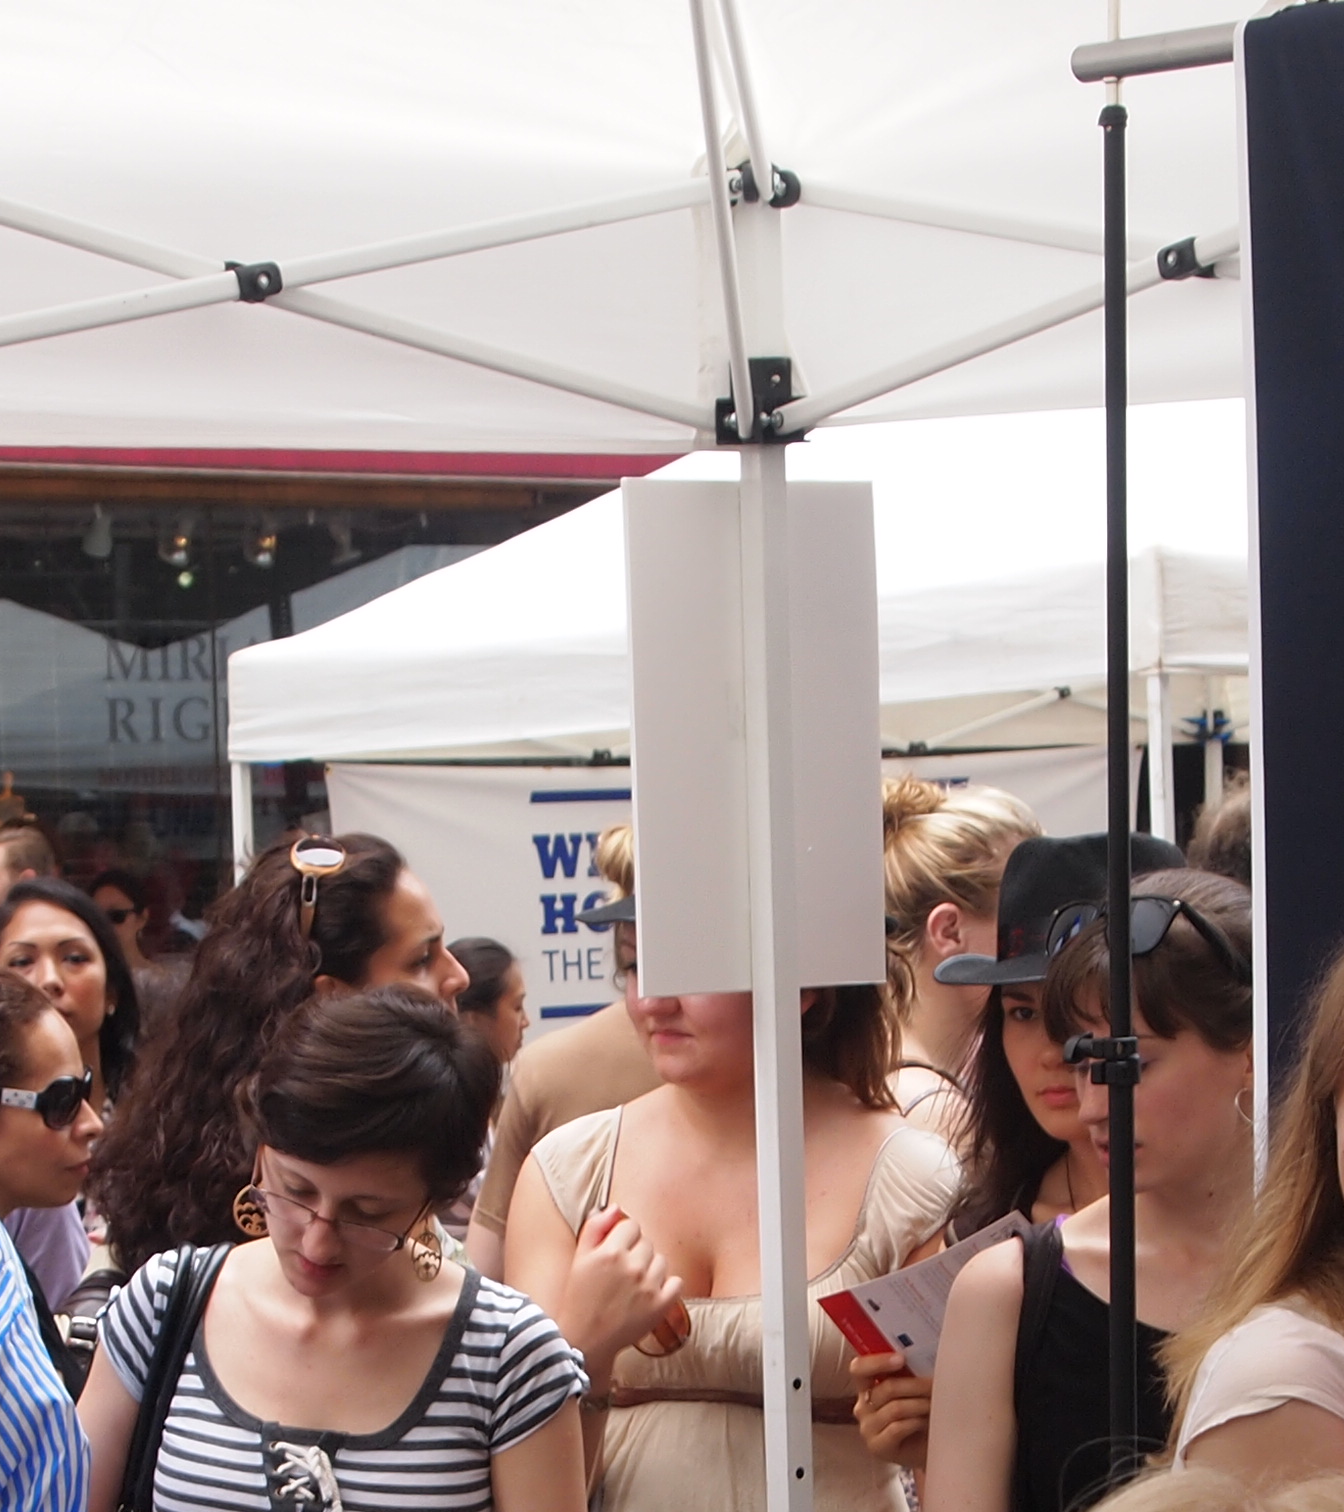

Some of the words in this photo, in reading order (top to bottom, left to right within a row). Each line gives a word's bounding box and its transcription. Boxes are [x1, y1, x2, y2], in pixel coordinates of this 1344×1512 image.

[102, 634, 256, 683] MIRI
[105, 696, 230, 744] RIG
[541, 947, 605, 982] THE
